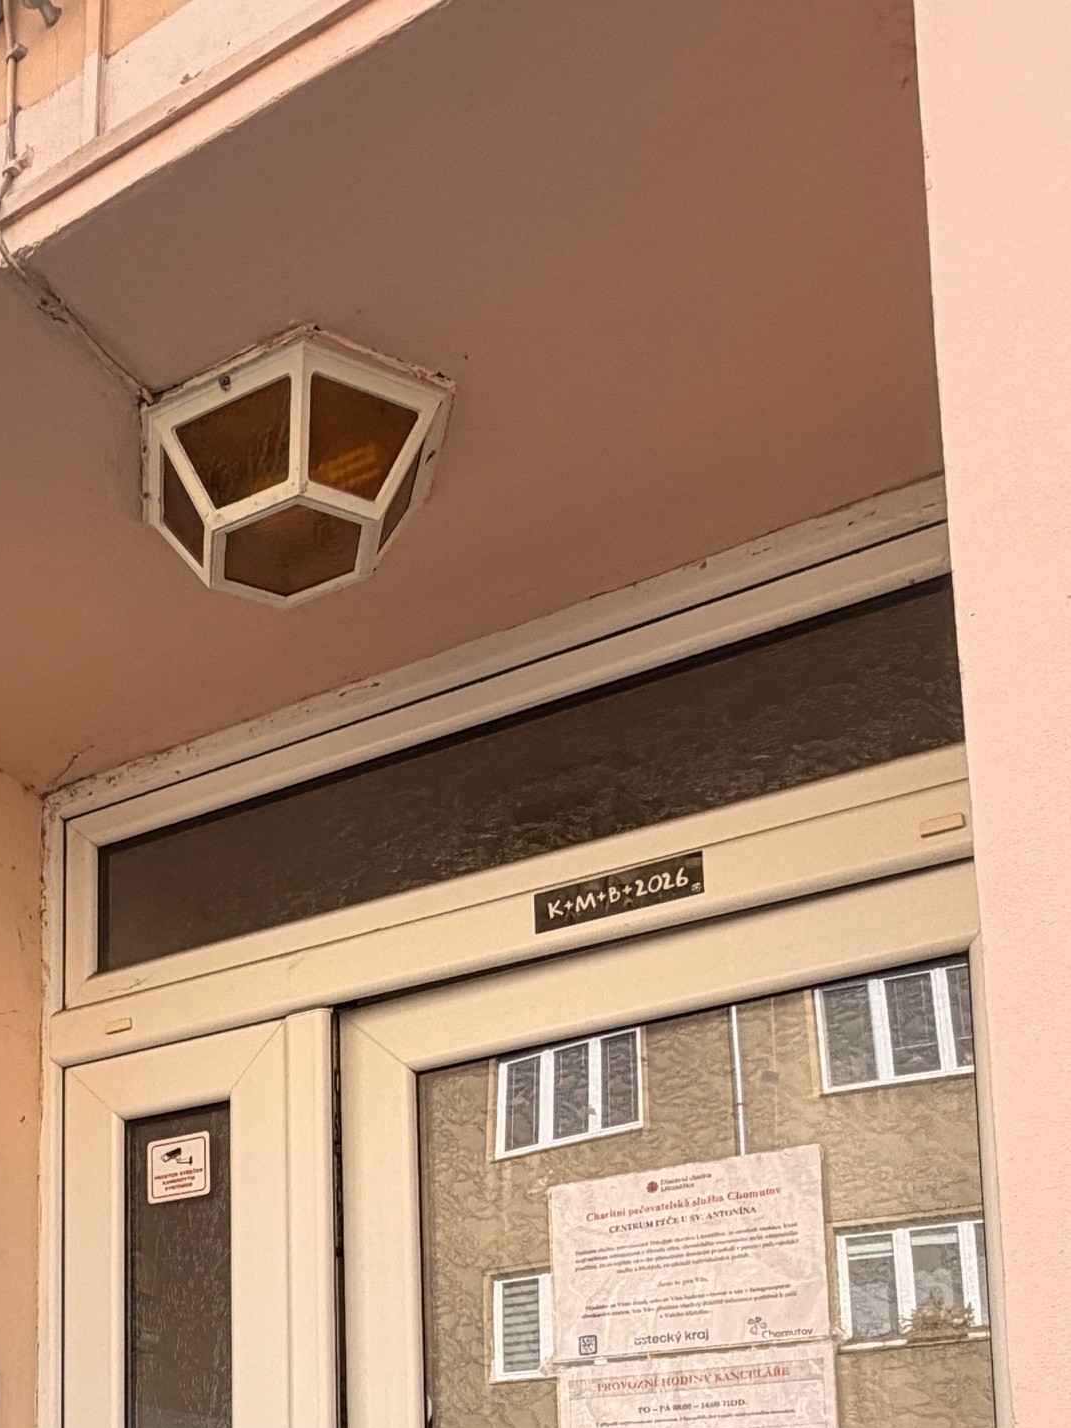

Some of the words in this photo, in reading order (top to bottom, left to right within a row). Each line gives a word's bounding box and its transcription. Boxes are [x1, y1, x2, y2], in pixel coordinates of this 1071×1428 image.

[547, 866, 689, 920] K+M+B+2026
[727, 1186, 782, 1202] Chomutov
[609, 1219, 654, 1234] CENTRUM
[706, 1205, 758, 1221] ANTONÍNA
[684, 1328, 710, 1342] kraj
[761, 1326, 814, 1340] Chomutov
[596, 1377, 658, 1393] PROVOZNÍ
[714, 1364, 791, 1383] KANCELÁŘE
